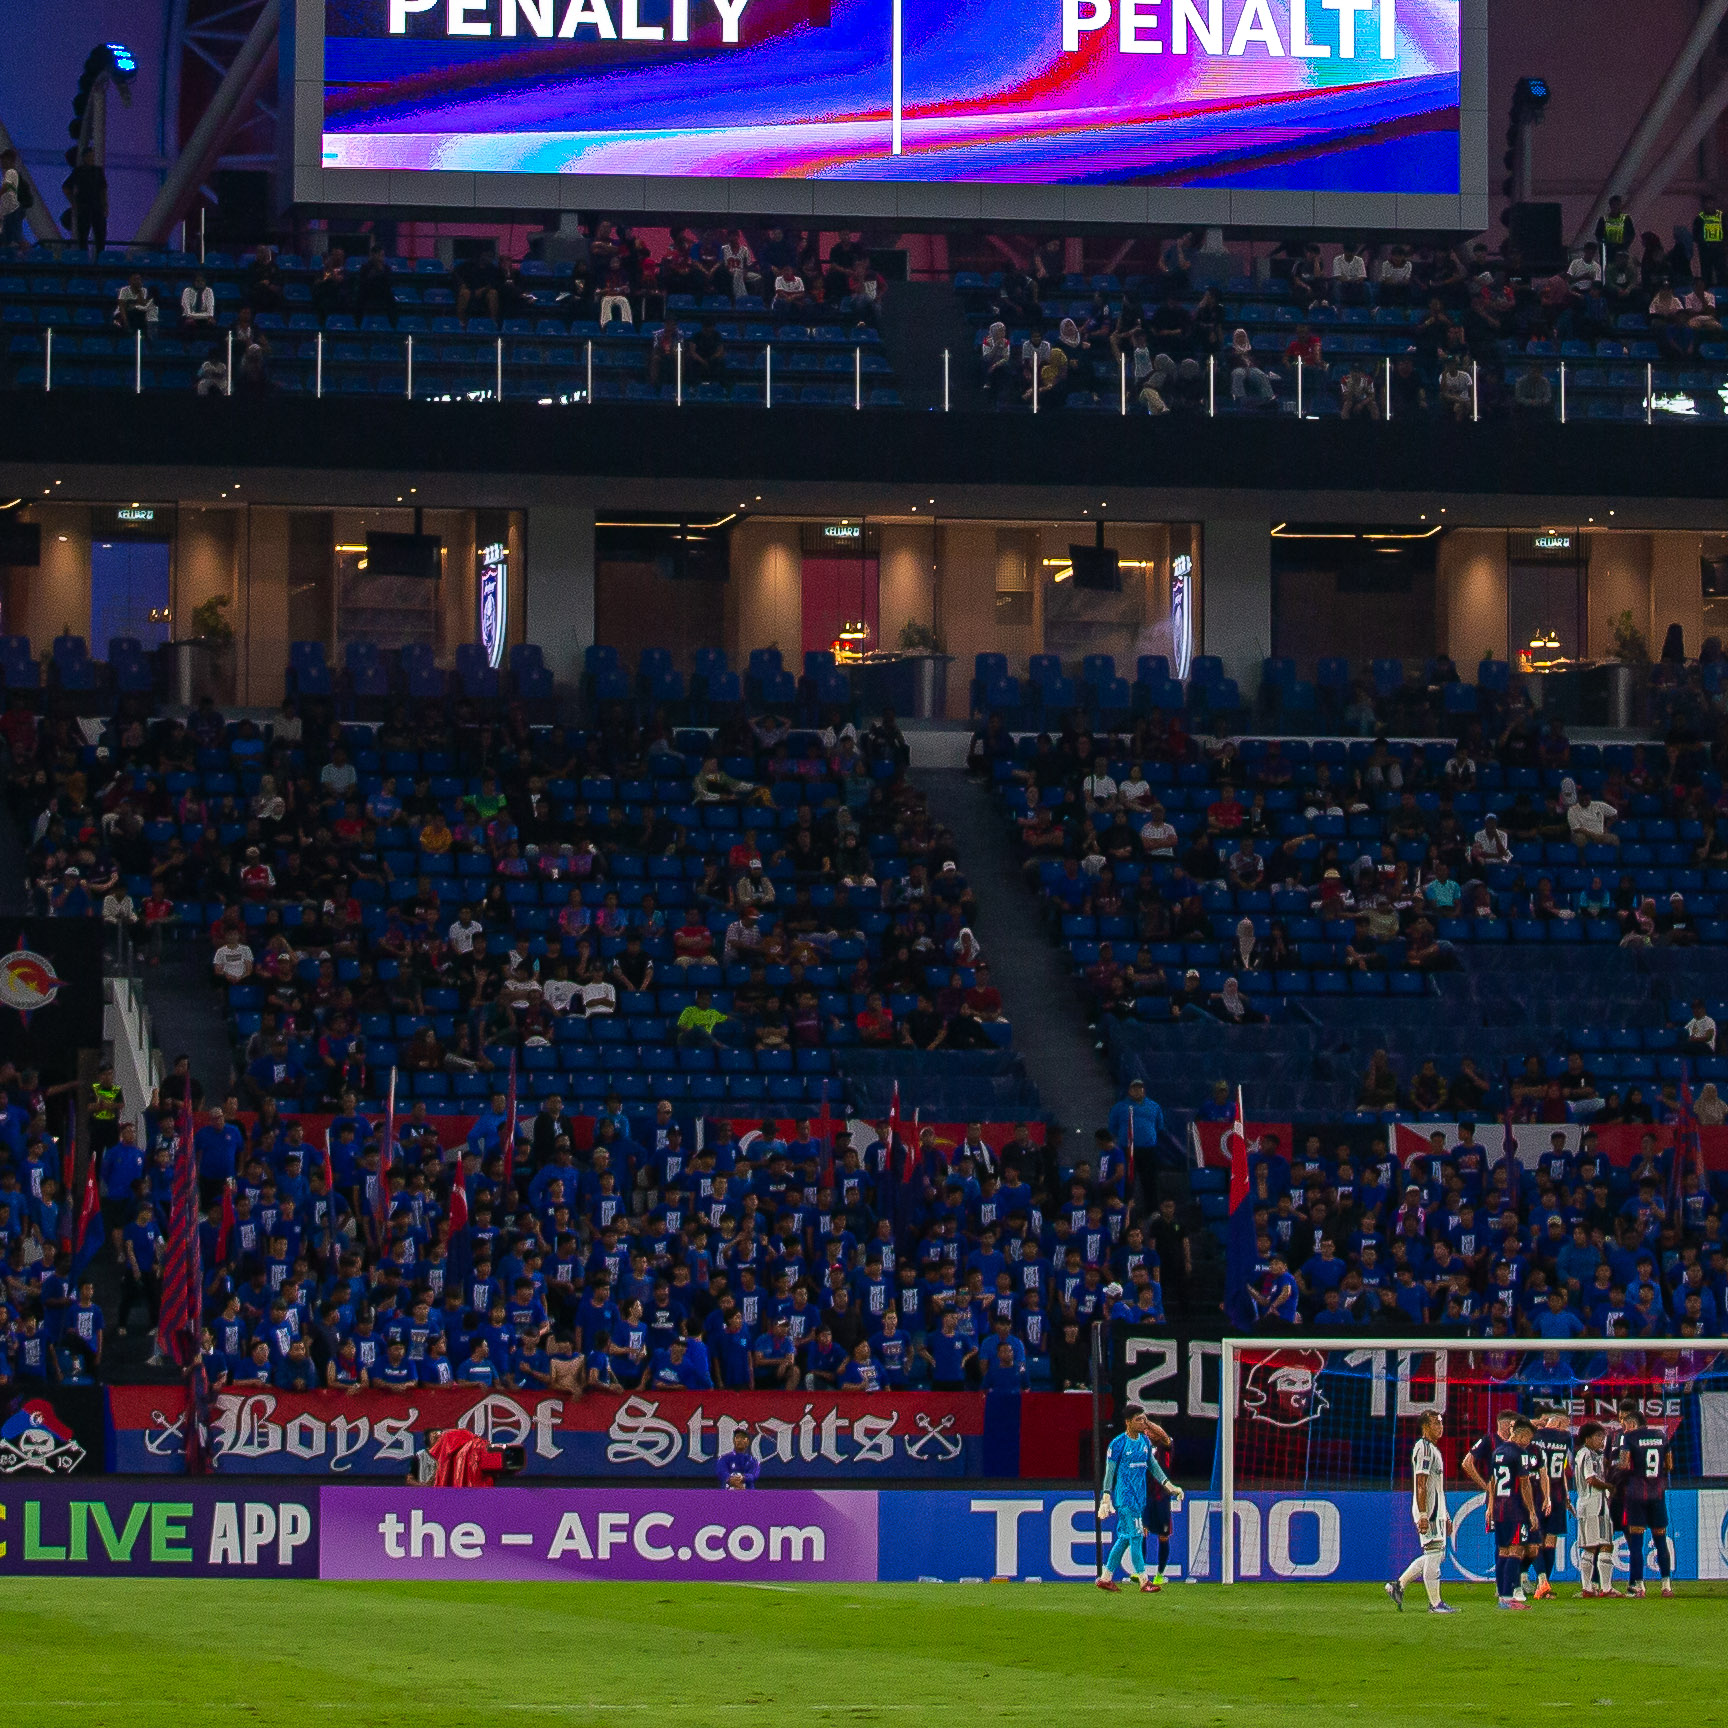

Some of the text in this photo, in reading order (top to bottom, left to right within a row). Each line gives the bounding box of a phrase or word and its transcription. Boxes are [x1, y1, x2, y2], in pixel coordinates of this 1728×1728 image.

[211, 1393, 900, 1471] Boys Of Straits
[1595, 1398, 1682, 1416] NISE
[1645, 1448, 1660, 1478] 9
[208, 1502, 312, 1566] APP
[546, 1511, 827, 1563] AFC.com
